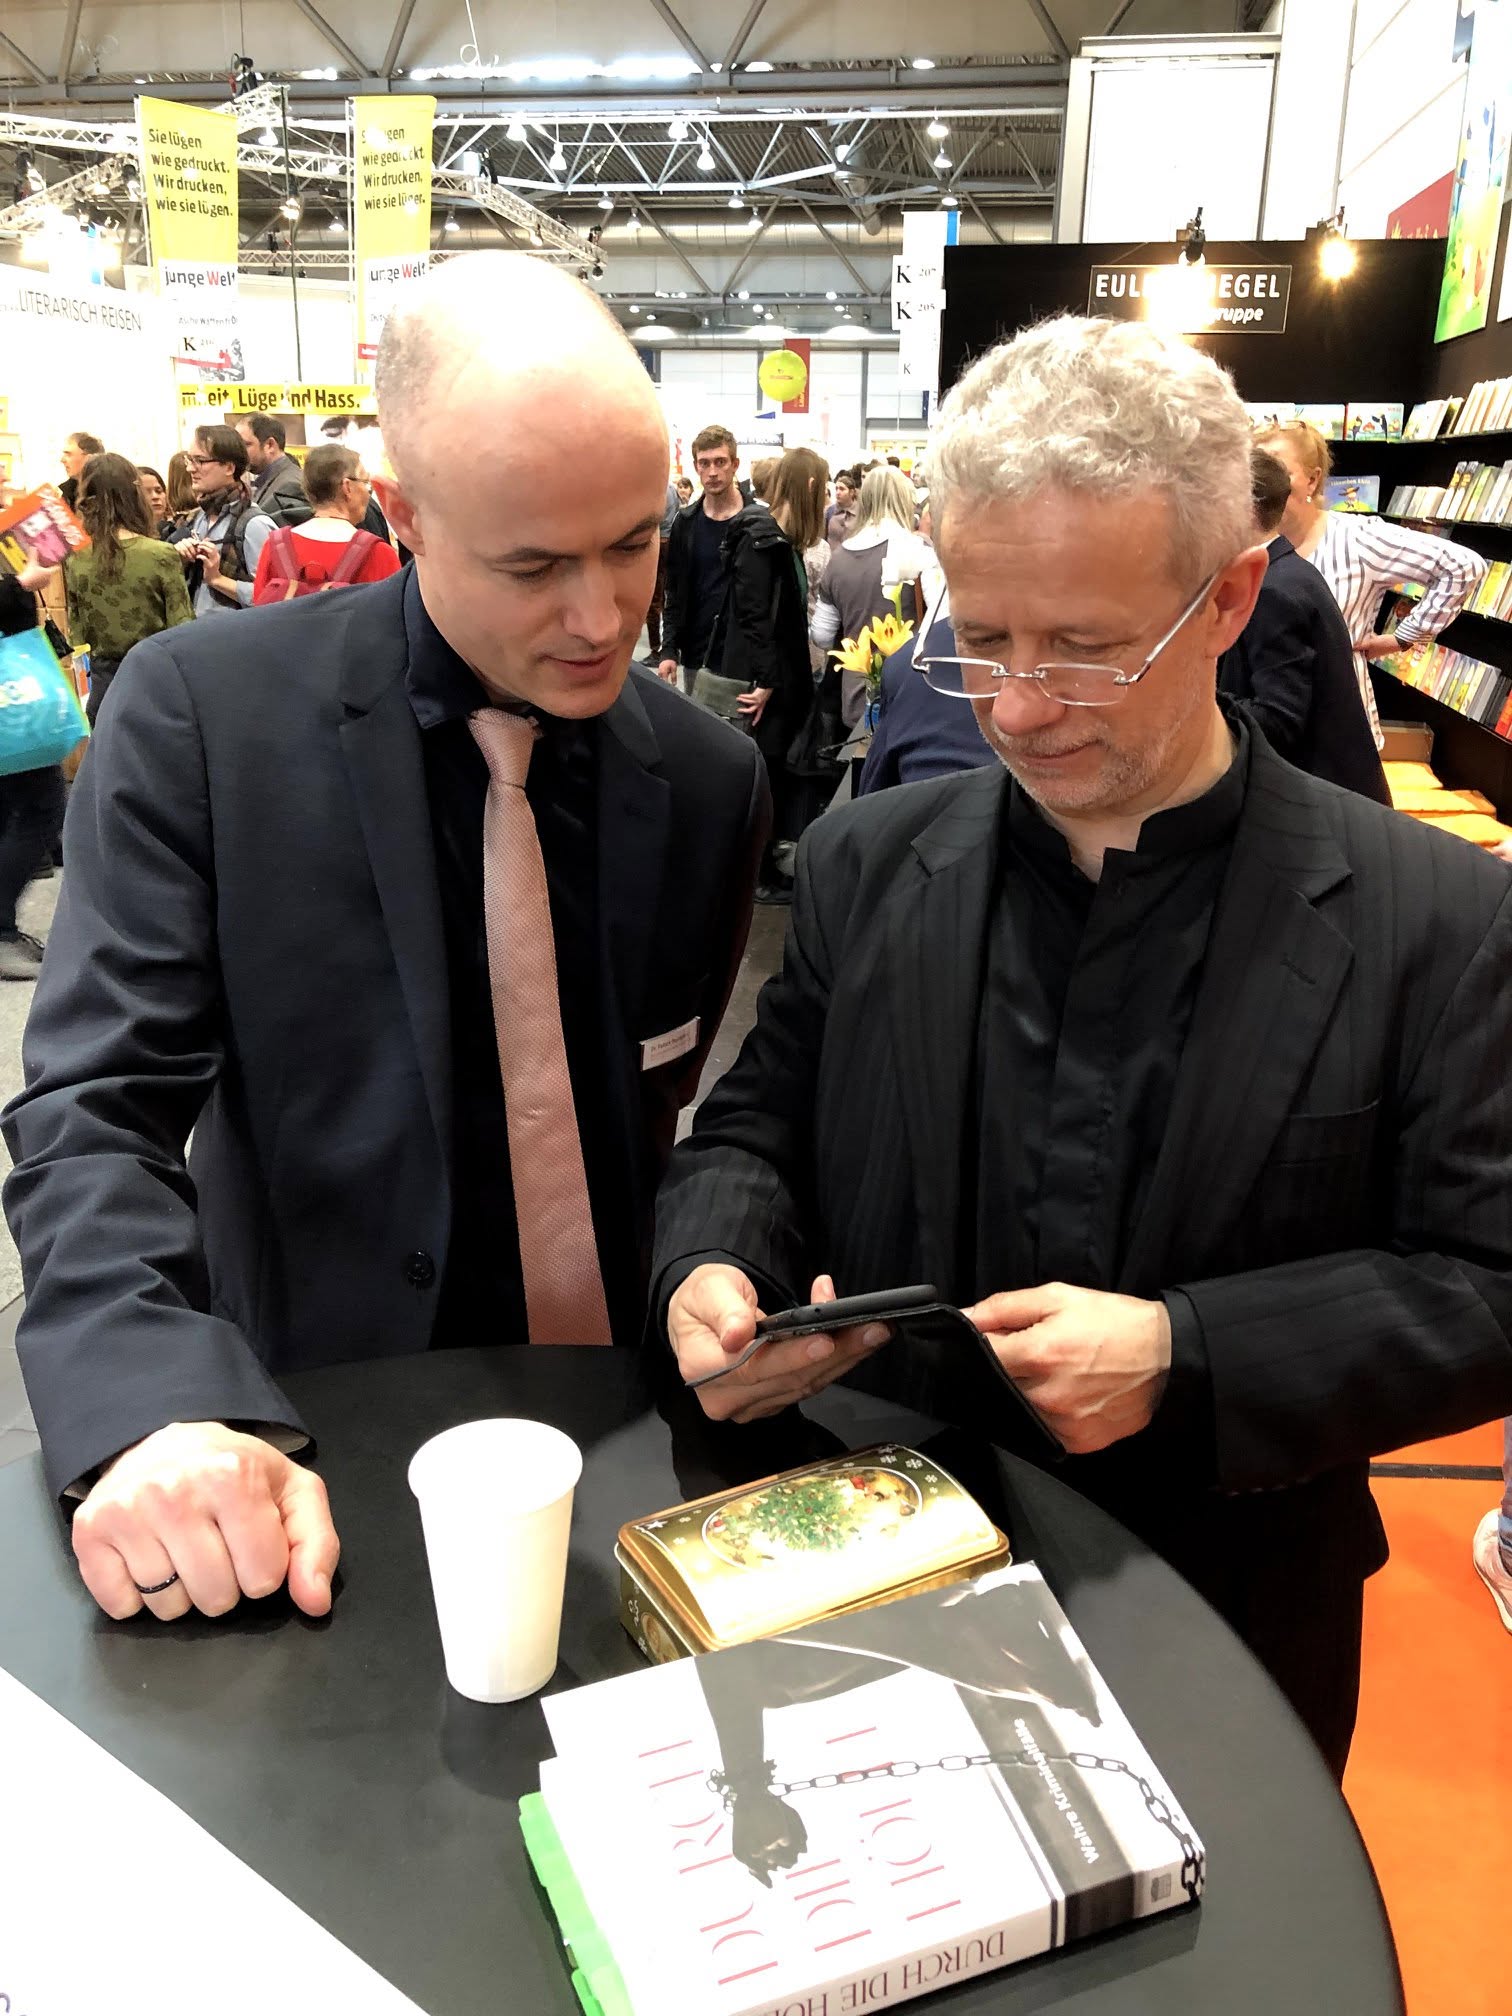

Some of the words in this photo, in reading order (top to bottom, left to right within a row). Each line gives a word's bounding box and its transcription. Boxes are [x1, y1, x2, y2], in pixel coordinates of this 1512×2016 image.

[148, 128, 167, 144] Sie
[169, 131, 202, 150] lügen
[151, 152, 172, 167] wie
[174, 155, 230, 173] gedruckt.
[362, 151, 379, 166] wie
[153, 173, 174, 189] Wir
[176, 176, 227, 196] drucken,
[363, 173, 380, 188] Wir
[381, 170, 423, 186] drucken,
[156, 196, 177, 212] wie
[179, 198, 196, 214] sie
[198, 200, 233, 218] lügen.
[364, 195, 381, 210] wie
[383, 193, 396, 208] sie
[165, 266, 205, 288] junge
[402, 261, 425, 279] Welt
[897, 265, 912, 283] K
[18, 289, 98, 325] LITERARISCH
[101, 304, 142, 332] REISEN
[897, 301, 912, 319] K
[183, 336, 197, 352] K
[903, 363, 911, 375] K
[239, 388, 278, 411] Lüge
[315, 389, 360, 408] Hass.
[1066, 1811, 1100, 1864] Wahre
[901, 1930, 1005, 1990] DURCH
[840, 1971, 889, 2012] DIE
